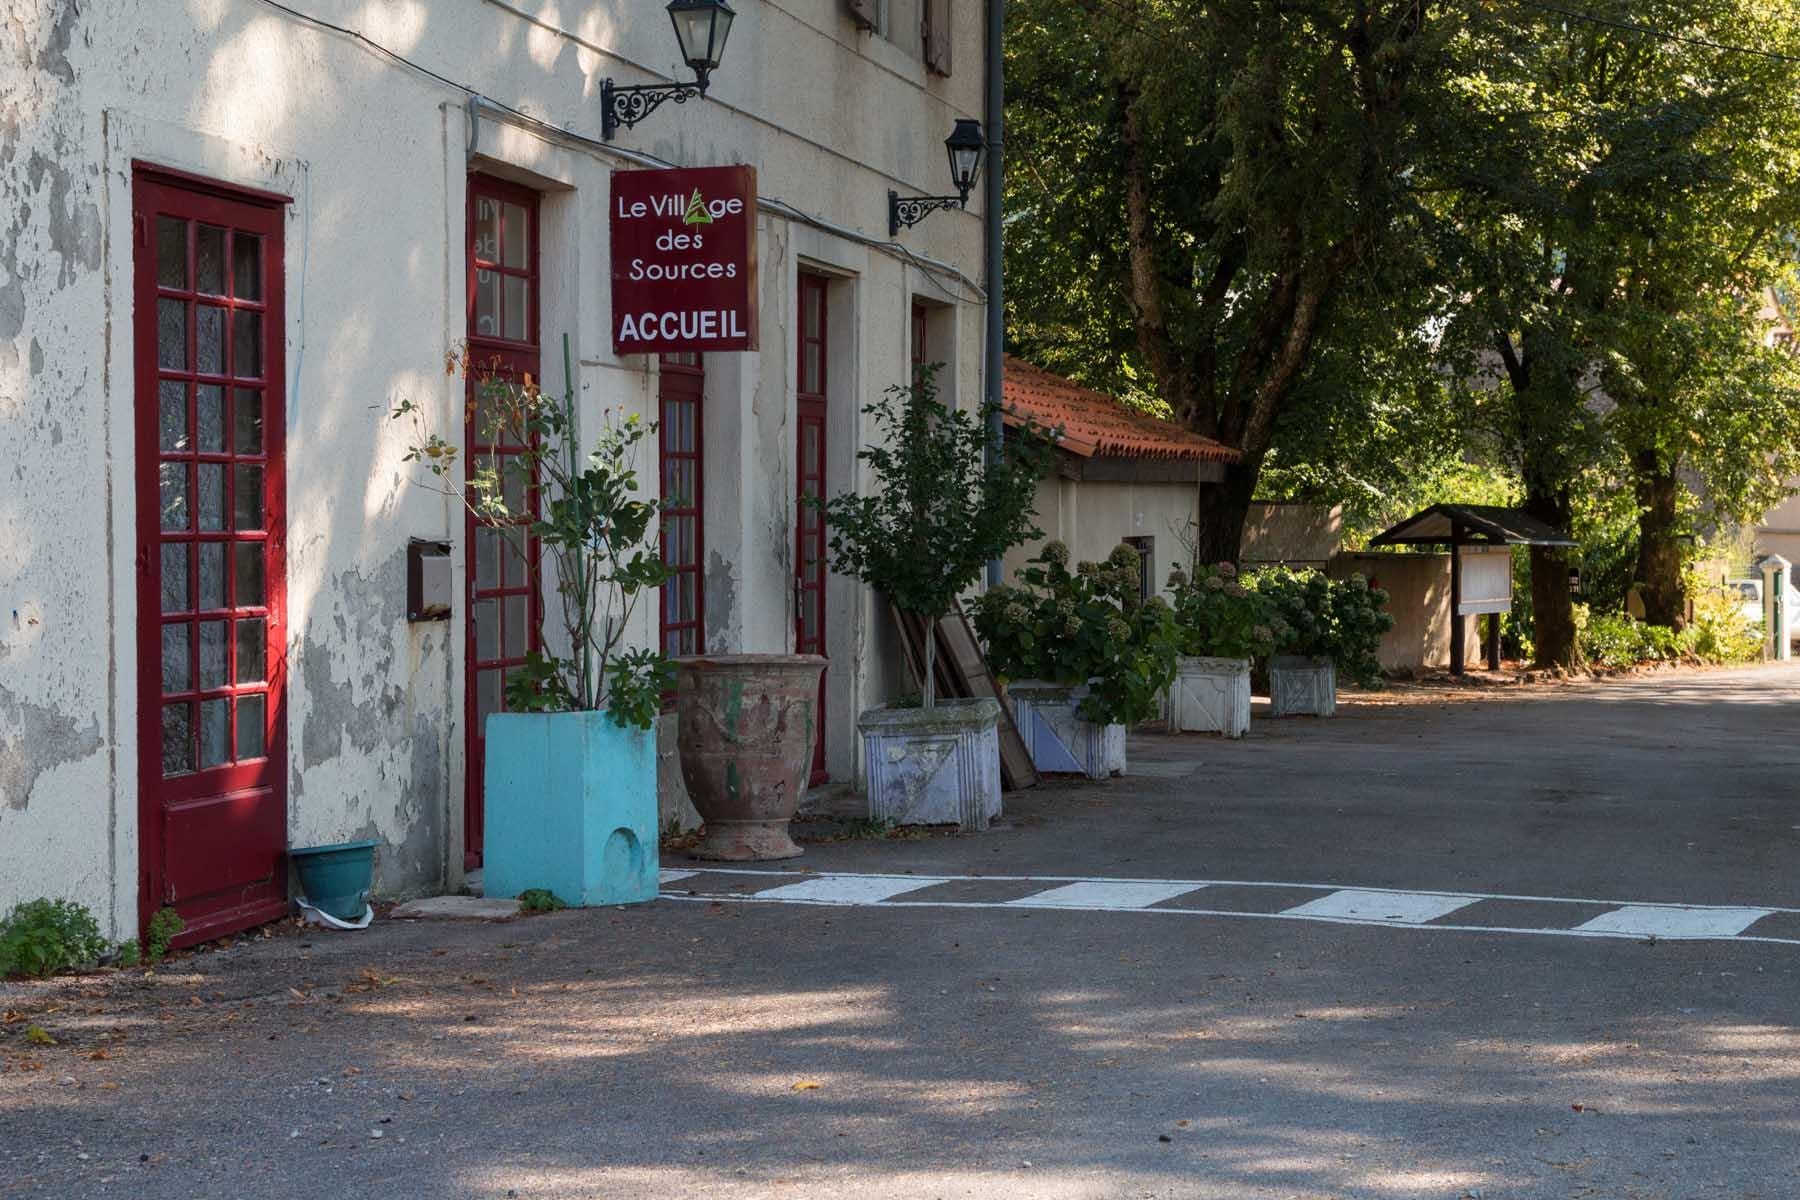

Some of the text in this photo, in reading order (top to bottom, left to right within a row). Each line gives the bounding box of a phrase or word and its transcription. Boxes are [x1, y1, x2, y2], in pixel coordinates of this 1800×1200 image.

[619, 196, 647, 218] Le
[656, 229, 703, 251] des
[629, 258, 736, 281] Sources
[619, 310, 746, 342] ACCUEIL
